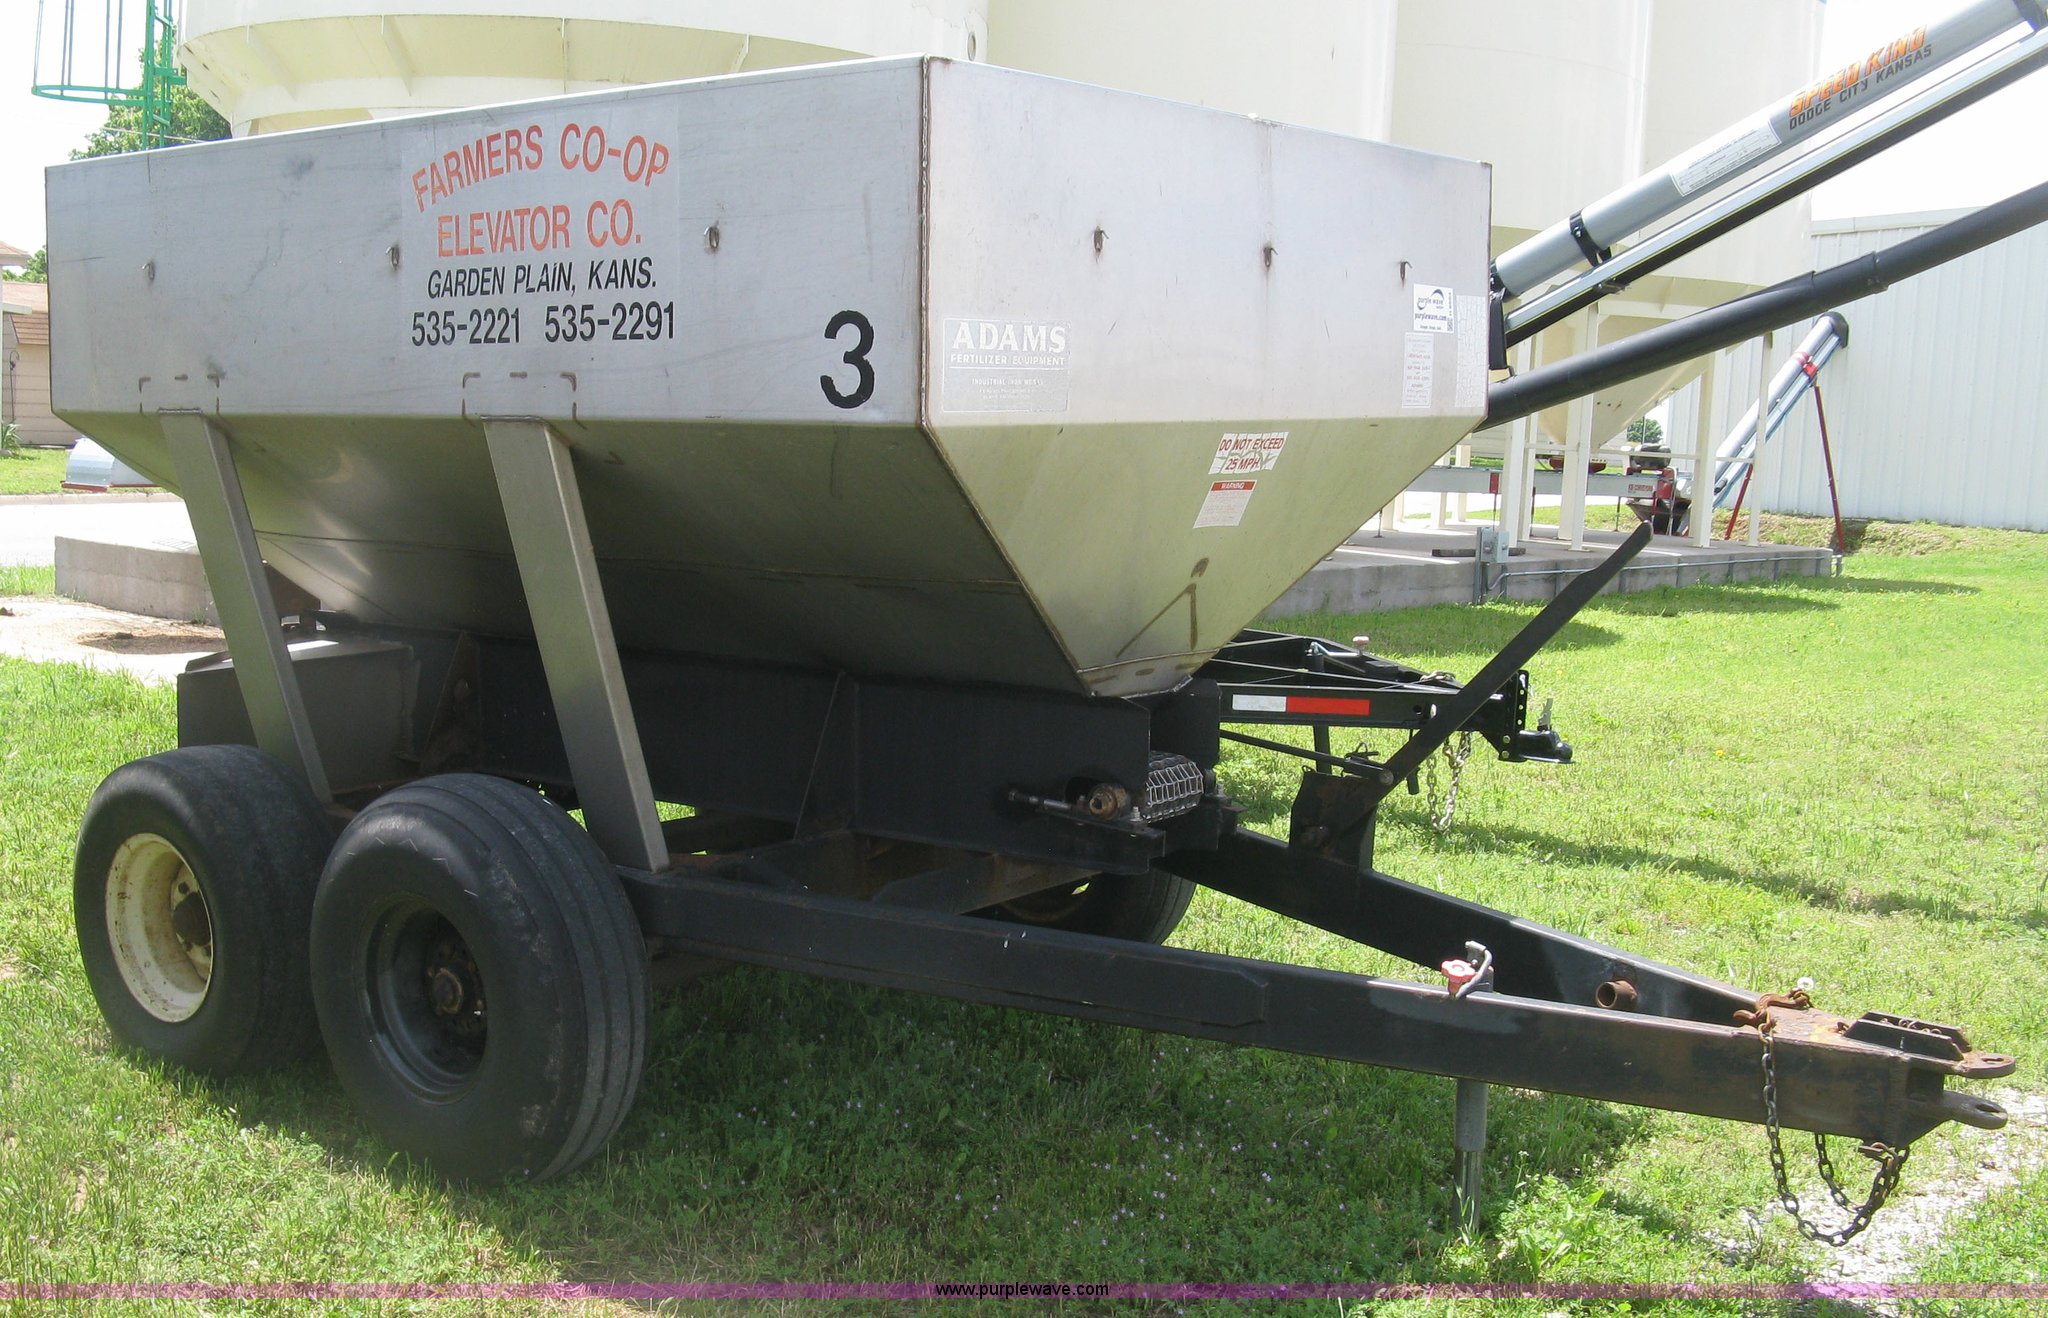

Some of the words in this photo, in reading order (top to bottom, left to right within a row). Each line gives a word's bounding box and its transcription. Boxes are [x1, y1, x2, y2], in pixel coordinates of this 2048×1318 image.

[1788, 61, 1862, 118] SPEED
[1863, 25, 1927, 78] KING
[1789, 98, 1831, 131] DODGE
[1839, 78, 1869, 104] CITY
[1875, 44, 1932, 84] KANSAS
[411, 124, 543, 213] FARMERS
[559, 122, 670, 187] CO-OP
[437, 204, 571, 258] ELEVATOR
[586, 198, 642, 248] CO.
[427, 266, 506, 299] GARDEN
[512, 262, 577, 297] PLAIN,
[587, 256, 657, 290] KANS.
[411, 307, 520, 347] 535-2221
[544, 301, 675, 343] 535-2291
[951, 321, 1067, 354] ADAMS
[820, 310, 875, 409] 3
[950, 353, 1008, 365] FERTILIZER
[1012, 355, 1066, 366] EQUIPMENT
[1219, 439, 1232, 452] DO
[1232, 438, 1253, 451] NOT
[1252, 437, 1285, 450] EXCEED
[1225, 458, 1237, 471] 25
[1220, 481, 1245, 490] WARNING
